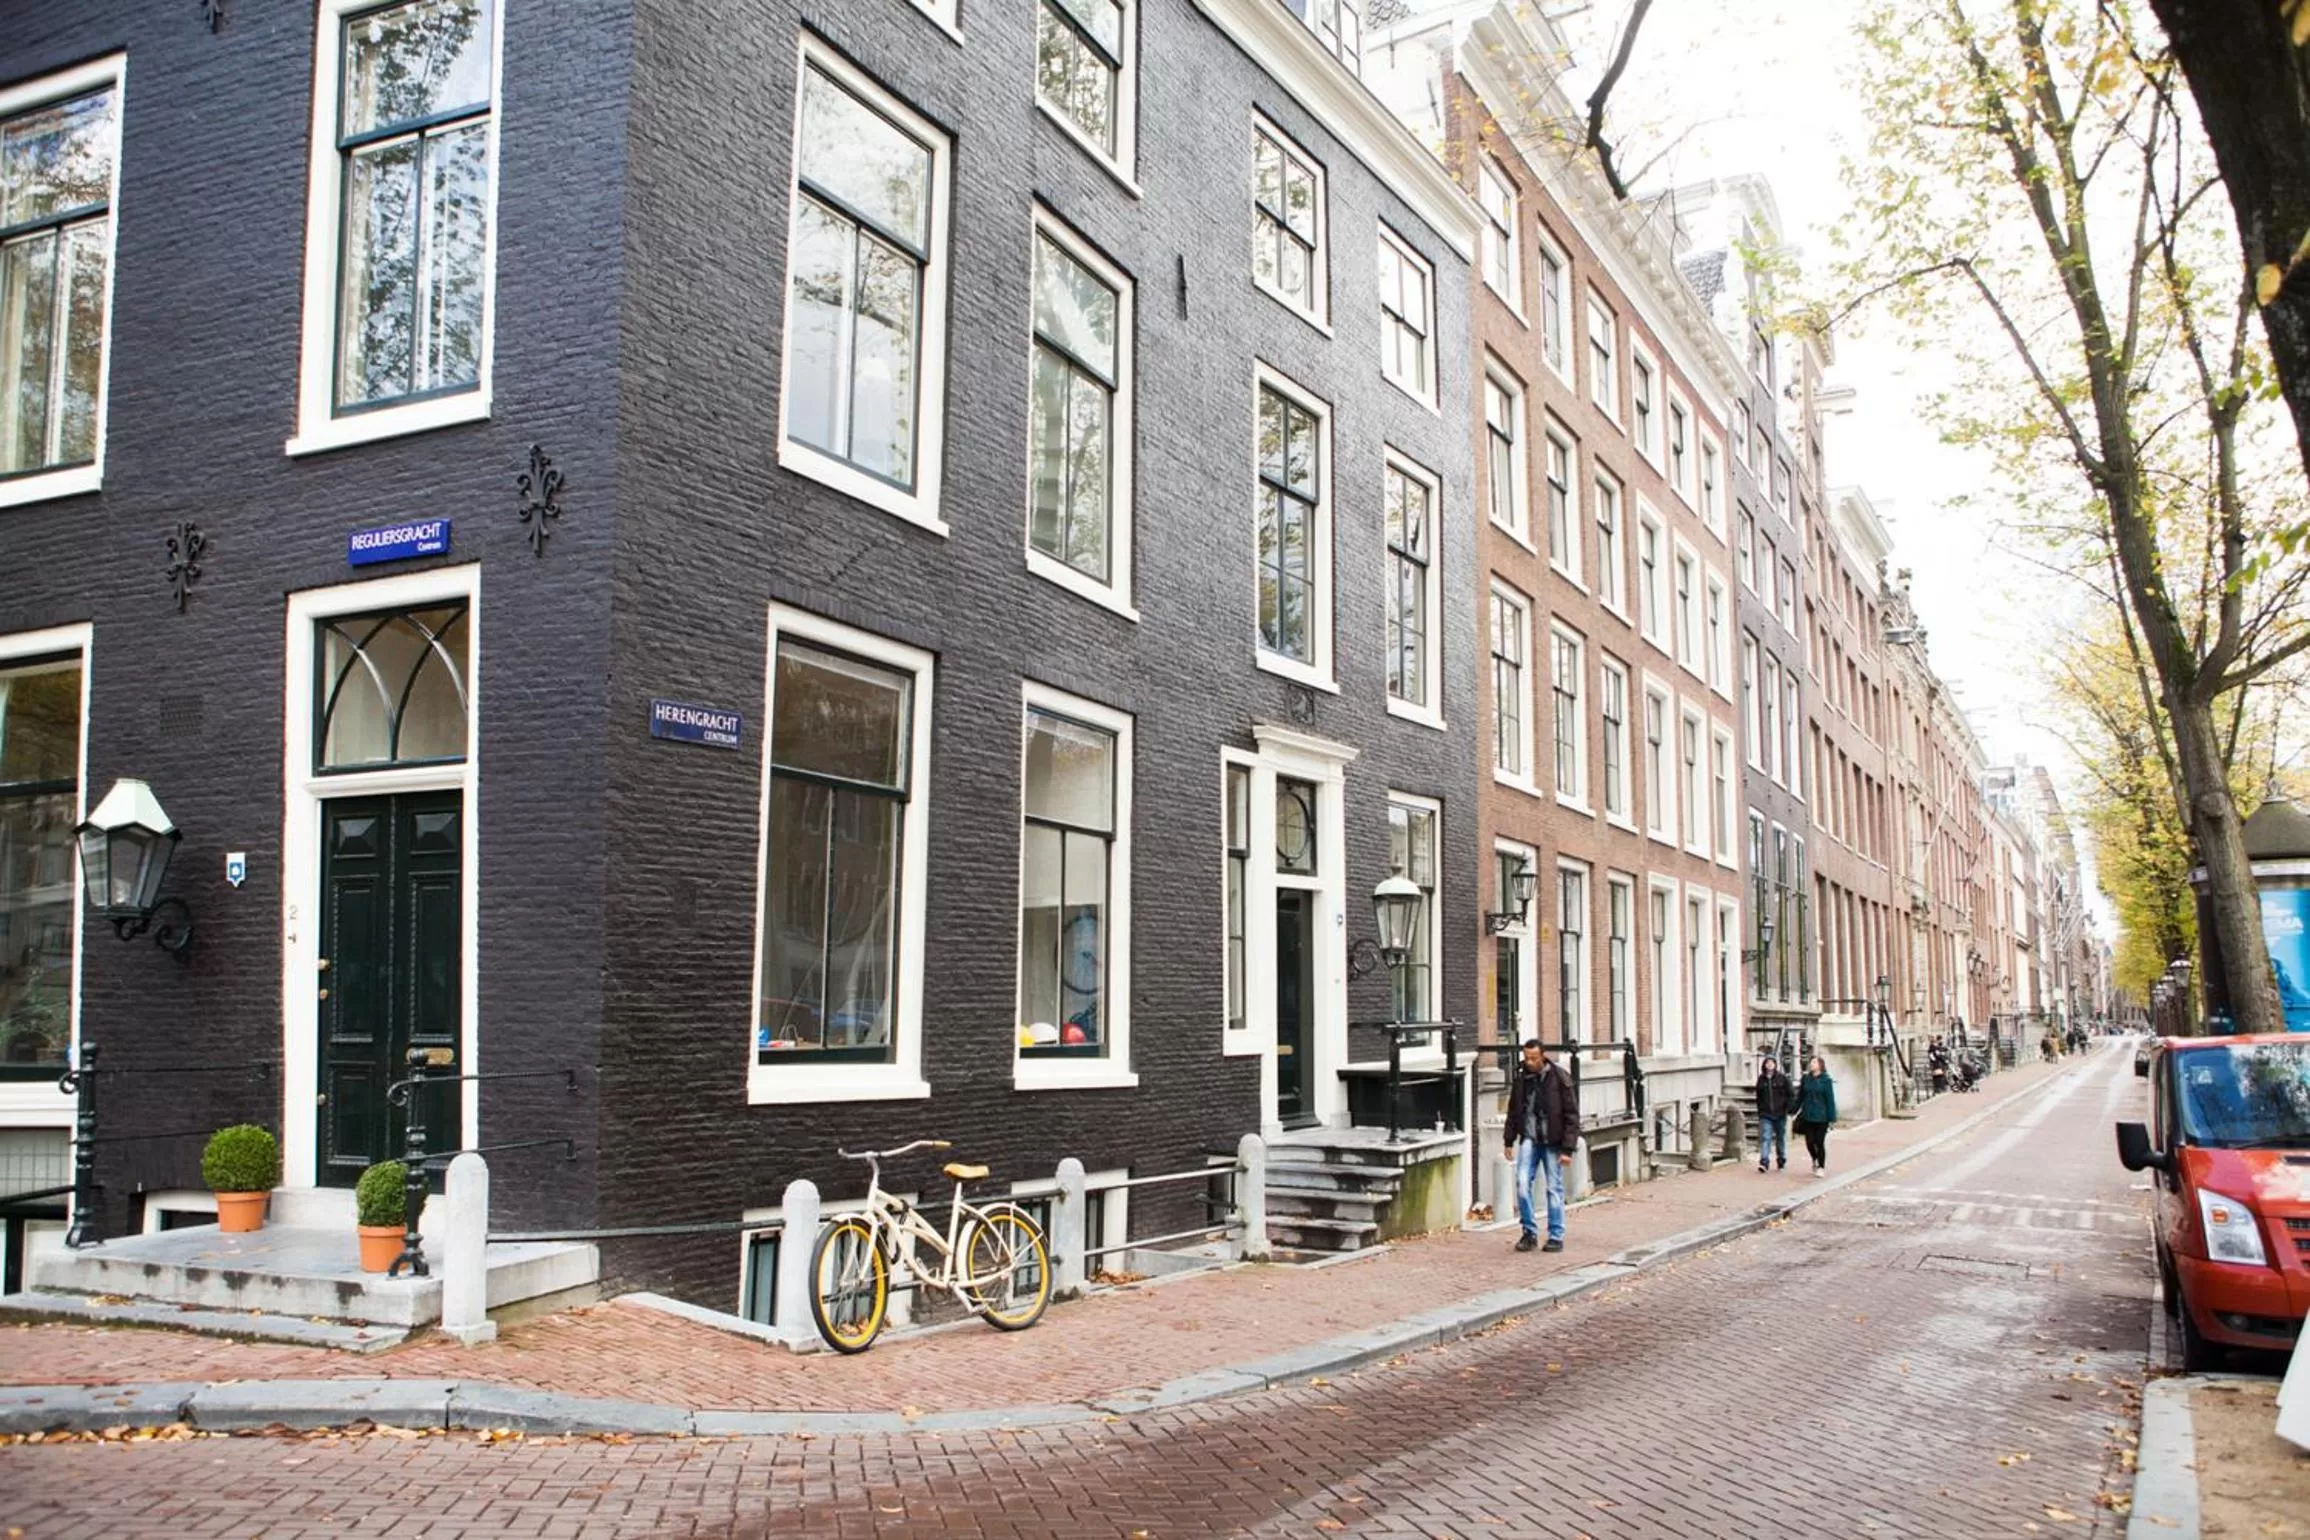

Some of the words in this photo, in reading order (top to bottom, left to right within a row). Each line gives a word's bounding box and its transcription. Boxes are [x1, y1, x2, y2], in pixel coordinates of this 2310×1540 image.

[351, 522, 442, 550] REGULIERSGRACHT
[655, 704, 738, 732] HERENGRACHT
[703, 730, 737, 744] CENTRUM
